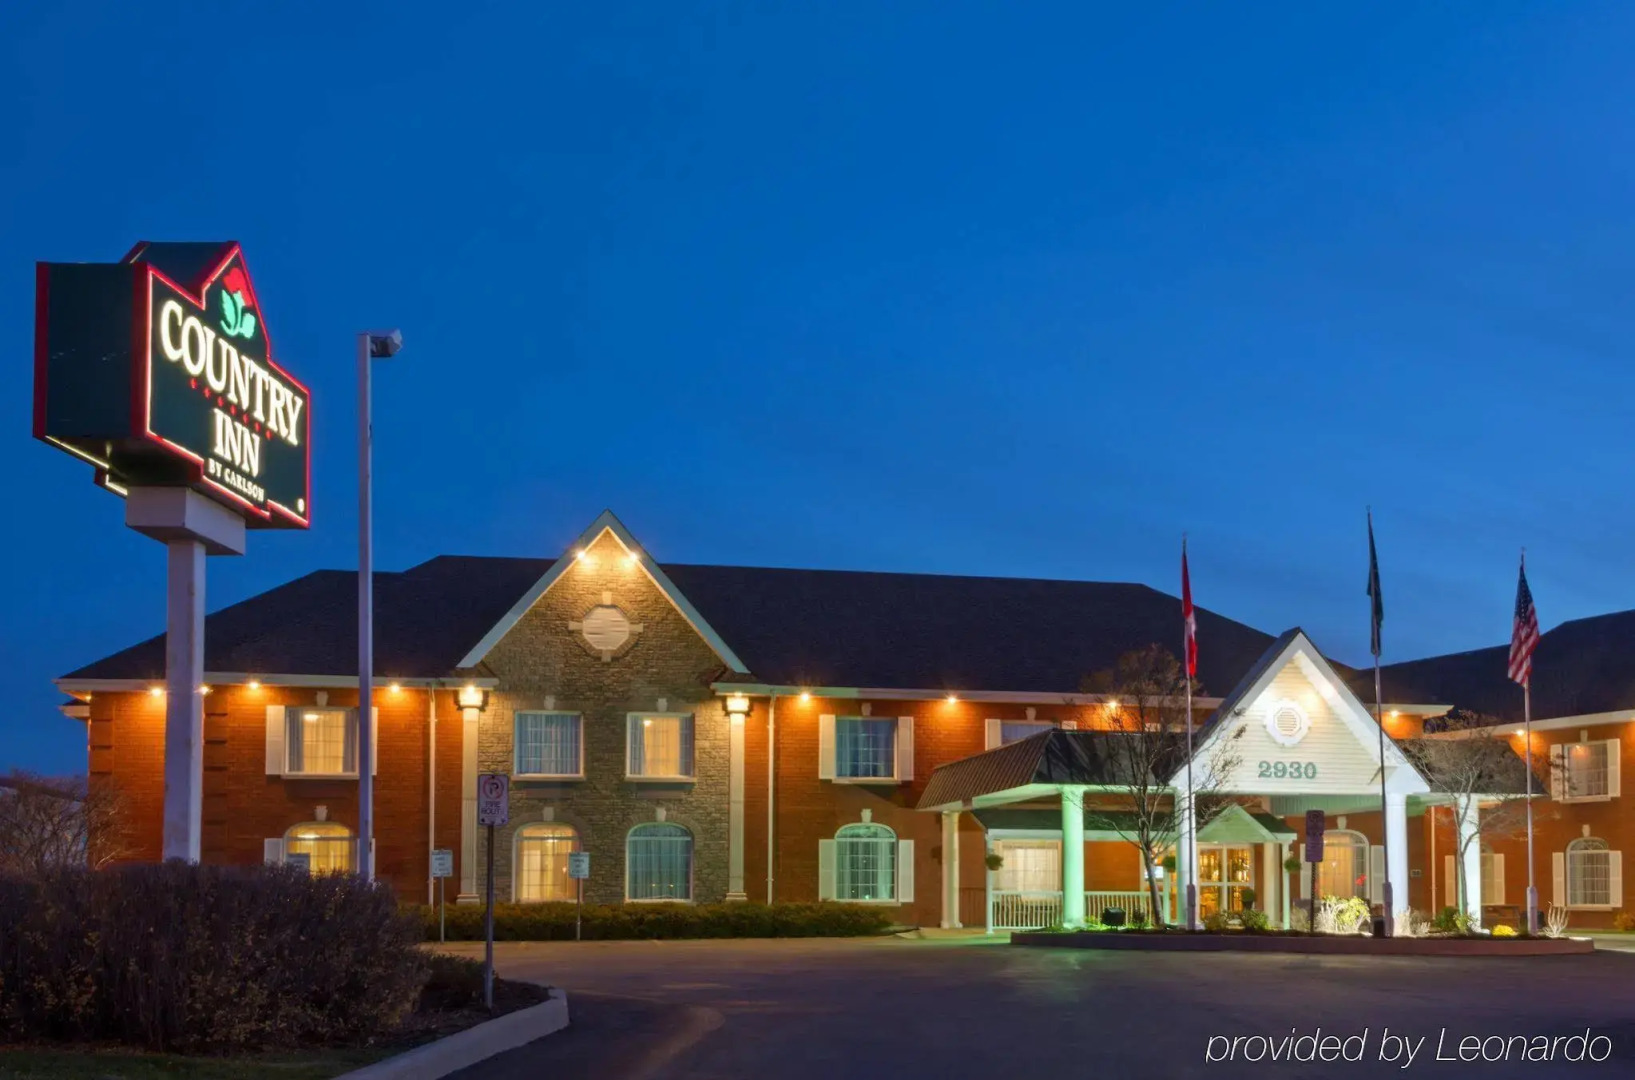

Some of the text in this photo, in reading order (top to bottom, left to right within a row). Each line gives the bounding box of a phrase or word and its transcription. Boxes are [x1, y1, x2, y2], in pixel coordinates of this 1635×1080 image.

[160, 299, 303, 446] COUNTRY
[213, 407, 261, 477] INN
[208, 458, 222, 478] BY
[1258, 760, 1317, 779] 2930
